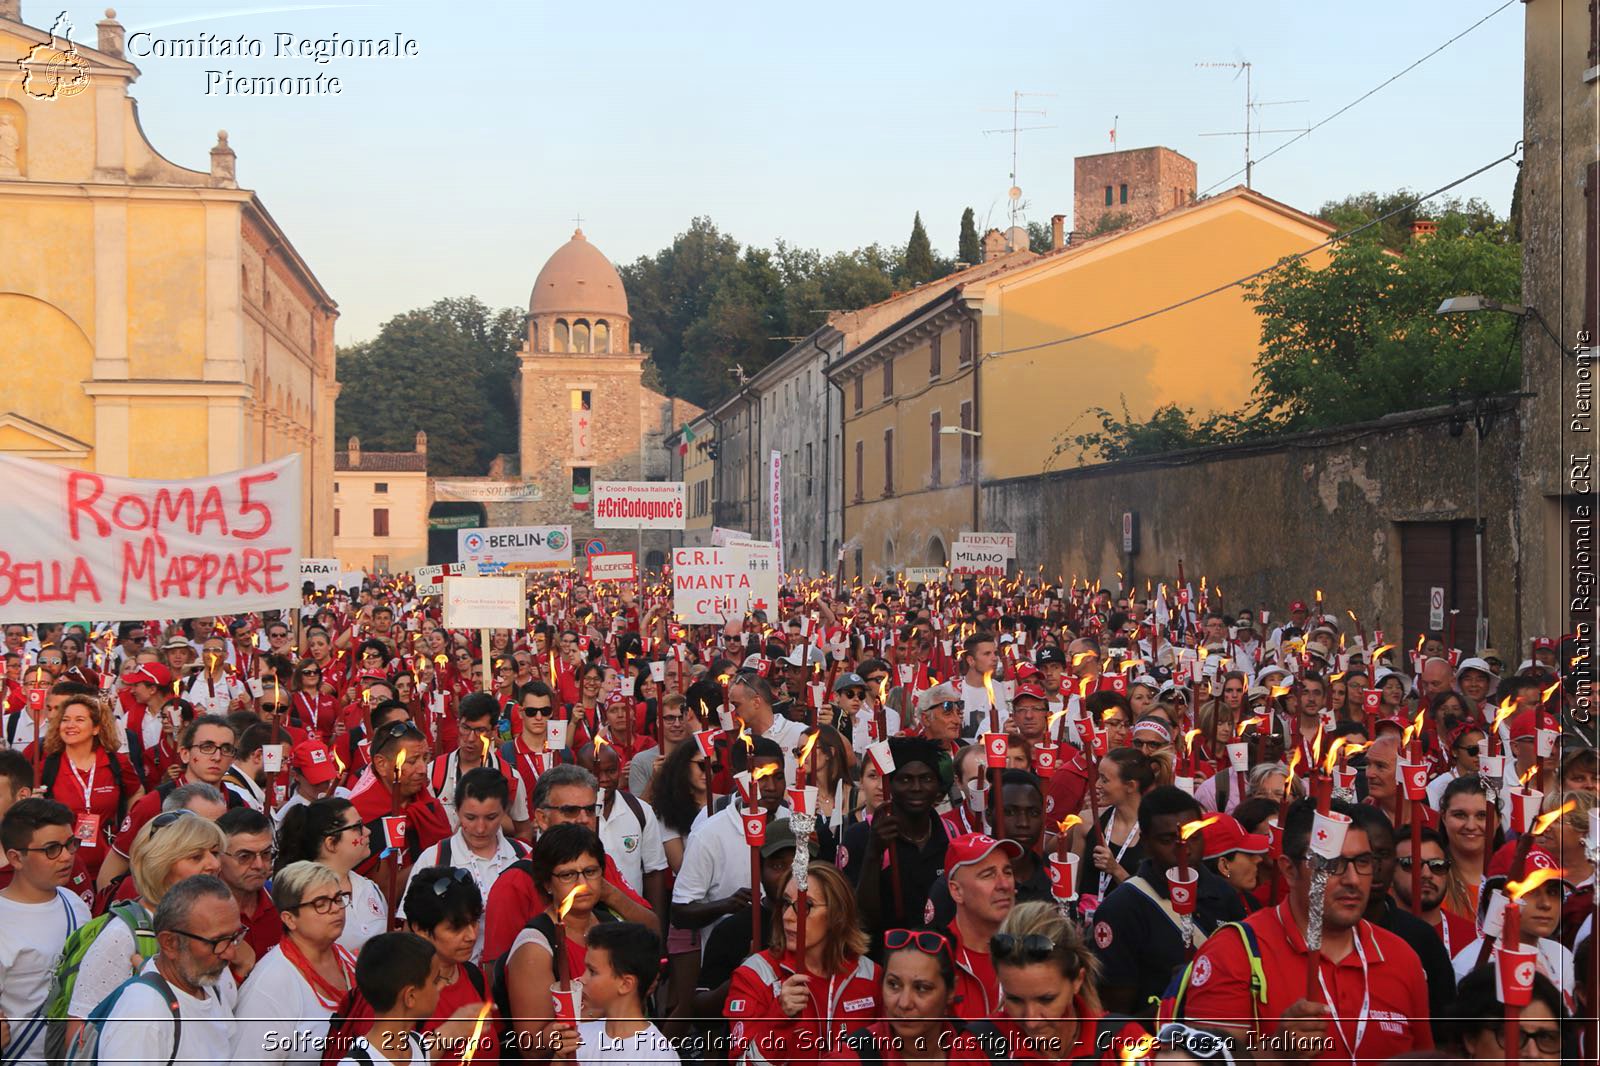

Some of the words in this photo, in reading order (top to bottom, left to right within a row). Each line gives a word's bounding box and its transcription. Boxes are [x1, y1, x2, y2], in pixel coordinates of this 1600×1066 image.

[606, 485, 625, 493] Croce
[628, 485, 649, 493] Rossa
[650, 485, 675, 493] Italiana
[67, 471, 229, 541] ROMA
[231, 472, 279, 540] 5
[597, 497, 683, 520] #CriCodognoc'è
[962, 535, 1015, 548] FIRENZE
[676, 551, 724, 566] C.R.I.
[956, 552, 1003, 562] MILANO
[0, 552, 103, 606] BELLA
[677, 574, 751, 589] MANTA
